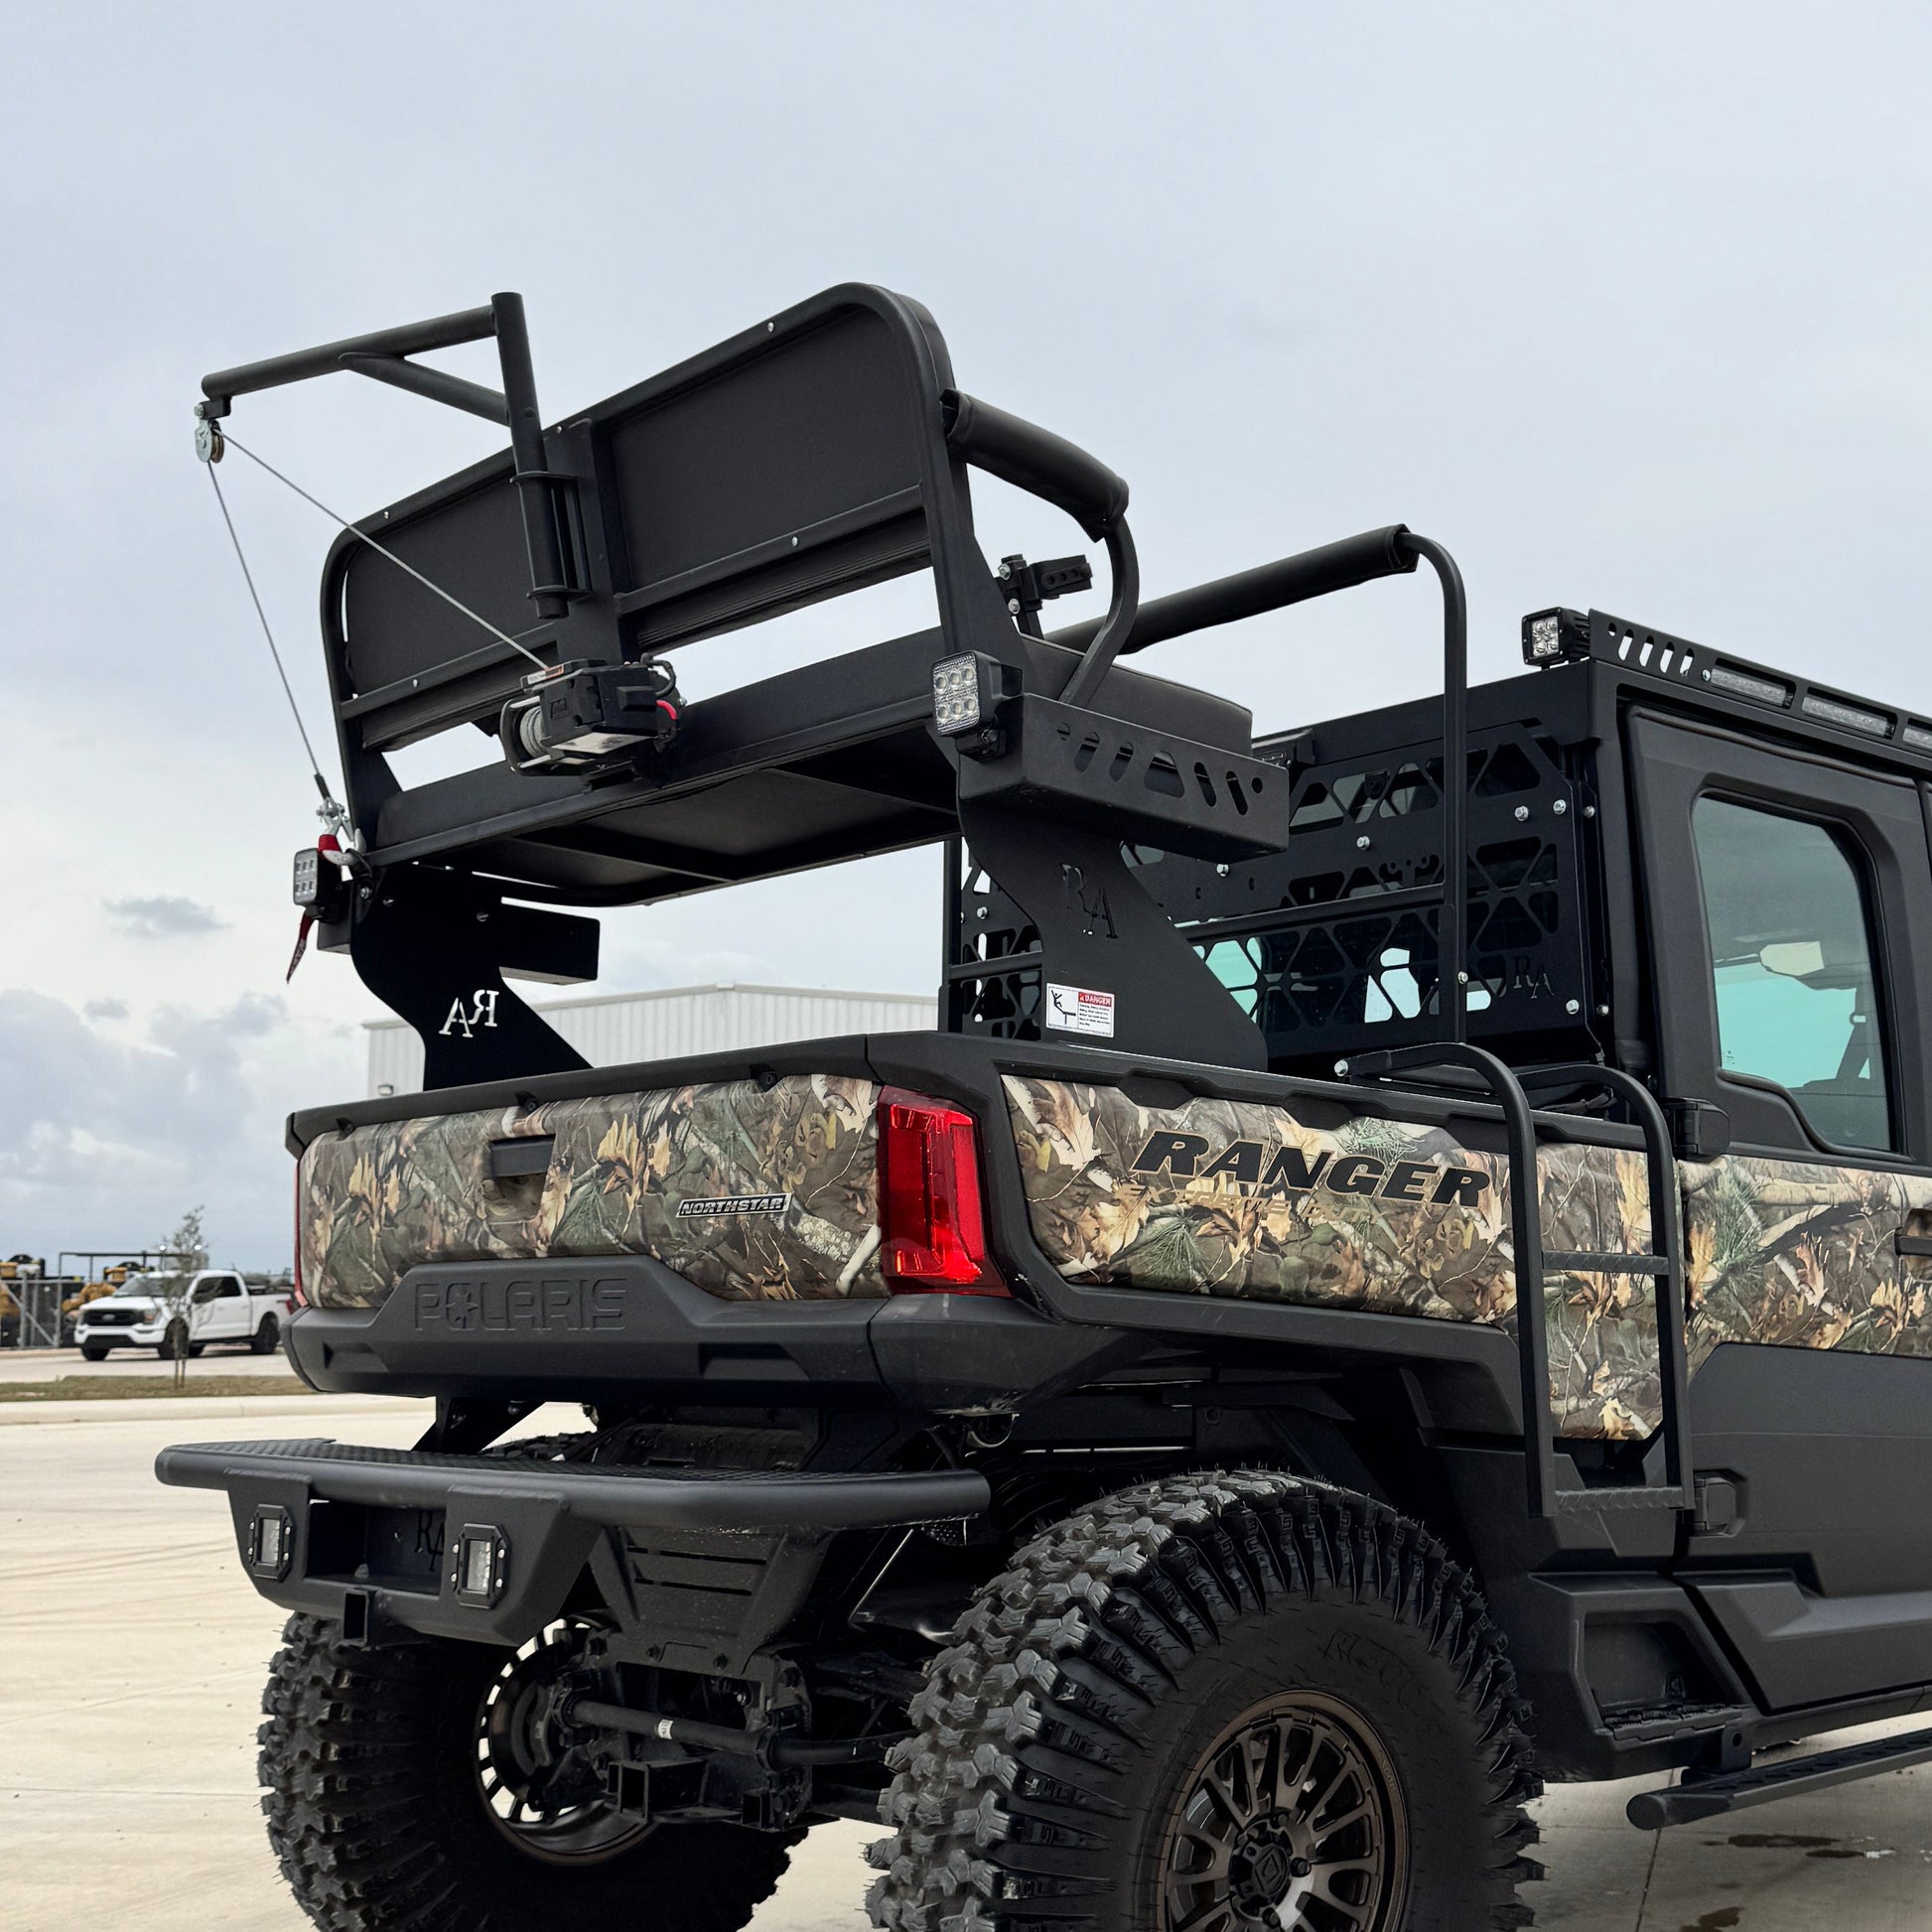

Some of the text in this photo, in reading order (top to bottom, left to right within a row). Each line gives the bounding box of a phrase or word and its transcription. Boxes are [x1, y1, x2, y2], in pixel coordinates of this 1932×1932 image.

[1128, 1129, 1492, 1208] RANGER
[680, 1197, 784, 1215] NORTHSTAR
[415, 1278, 628, 1331] POLARIS
